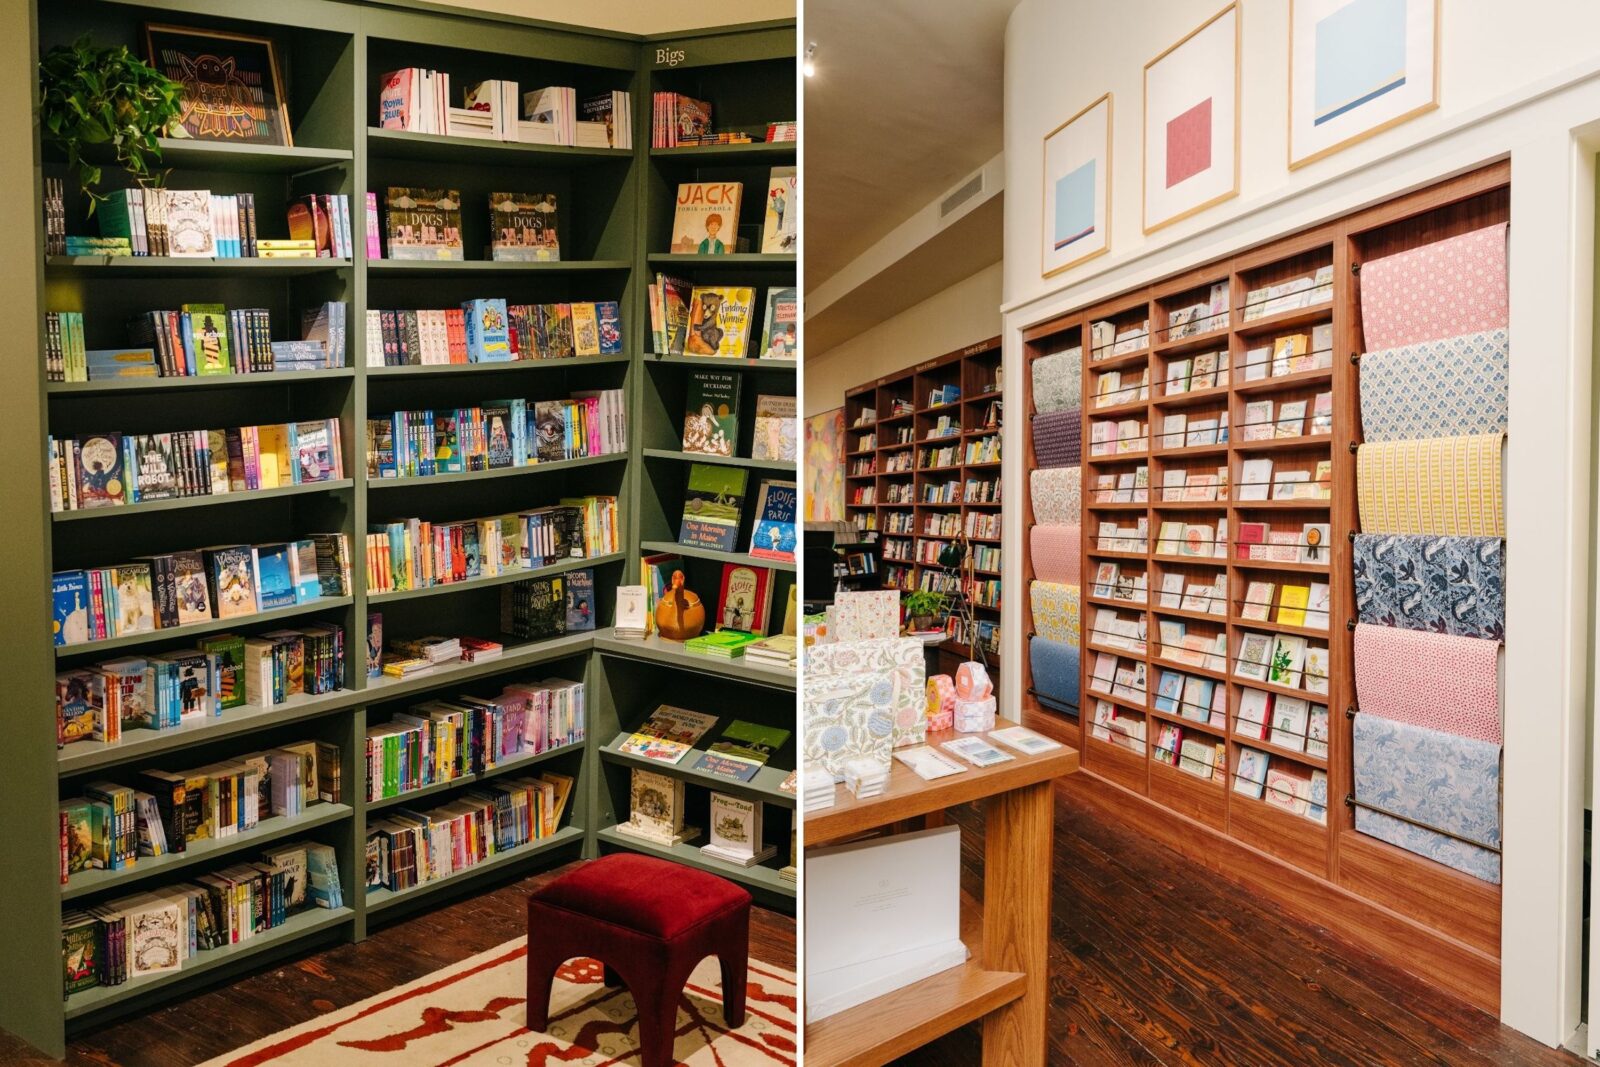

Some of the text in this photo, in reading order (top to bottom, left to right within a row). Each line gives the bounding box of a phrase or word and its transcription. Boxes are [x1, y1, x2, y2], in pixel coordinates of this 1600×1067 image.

[655, 48, 685, 66] Bigs
[383, 98, 404, 109] ROYAL
[678, 184, 735, 205] JACK
[411, 213, 443, 227] DOGS
[513, 216, 542, 229] DOGS
[720, 300, 748, 316] Finding
[719, 313, 744, 324] Winnie
[703, 382, 732, 390] DUCKLINGS
[142, 453, 162, 463] THE
[140, 463, 167, 475] WILD
[138, 472, 171, 486] ROBOT
[767, 490, 796, 511] ELOISE
[767, 509, 791, 521] PARIS
[686, 522, 727, 536] One Morning
[699, 532, 718, 542] Maine
[125, 674, 143, 684] UPON
[121, 684, 135, 694] TIM
[716, 765, 737, 774] Maine
[720, 759, 749, 771] Morning
[712, 795, 729, 806] Frog
[735, 801, 753, 812] Toad
